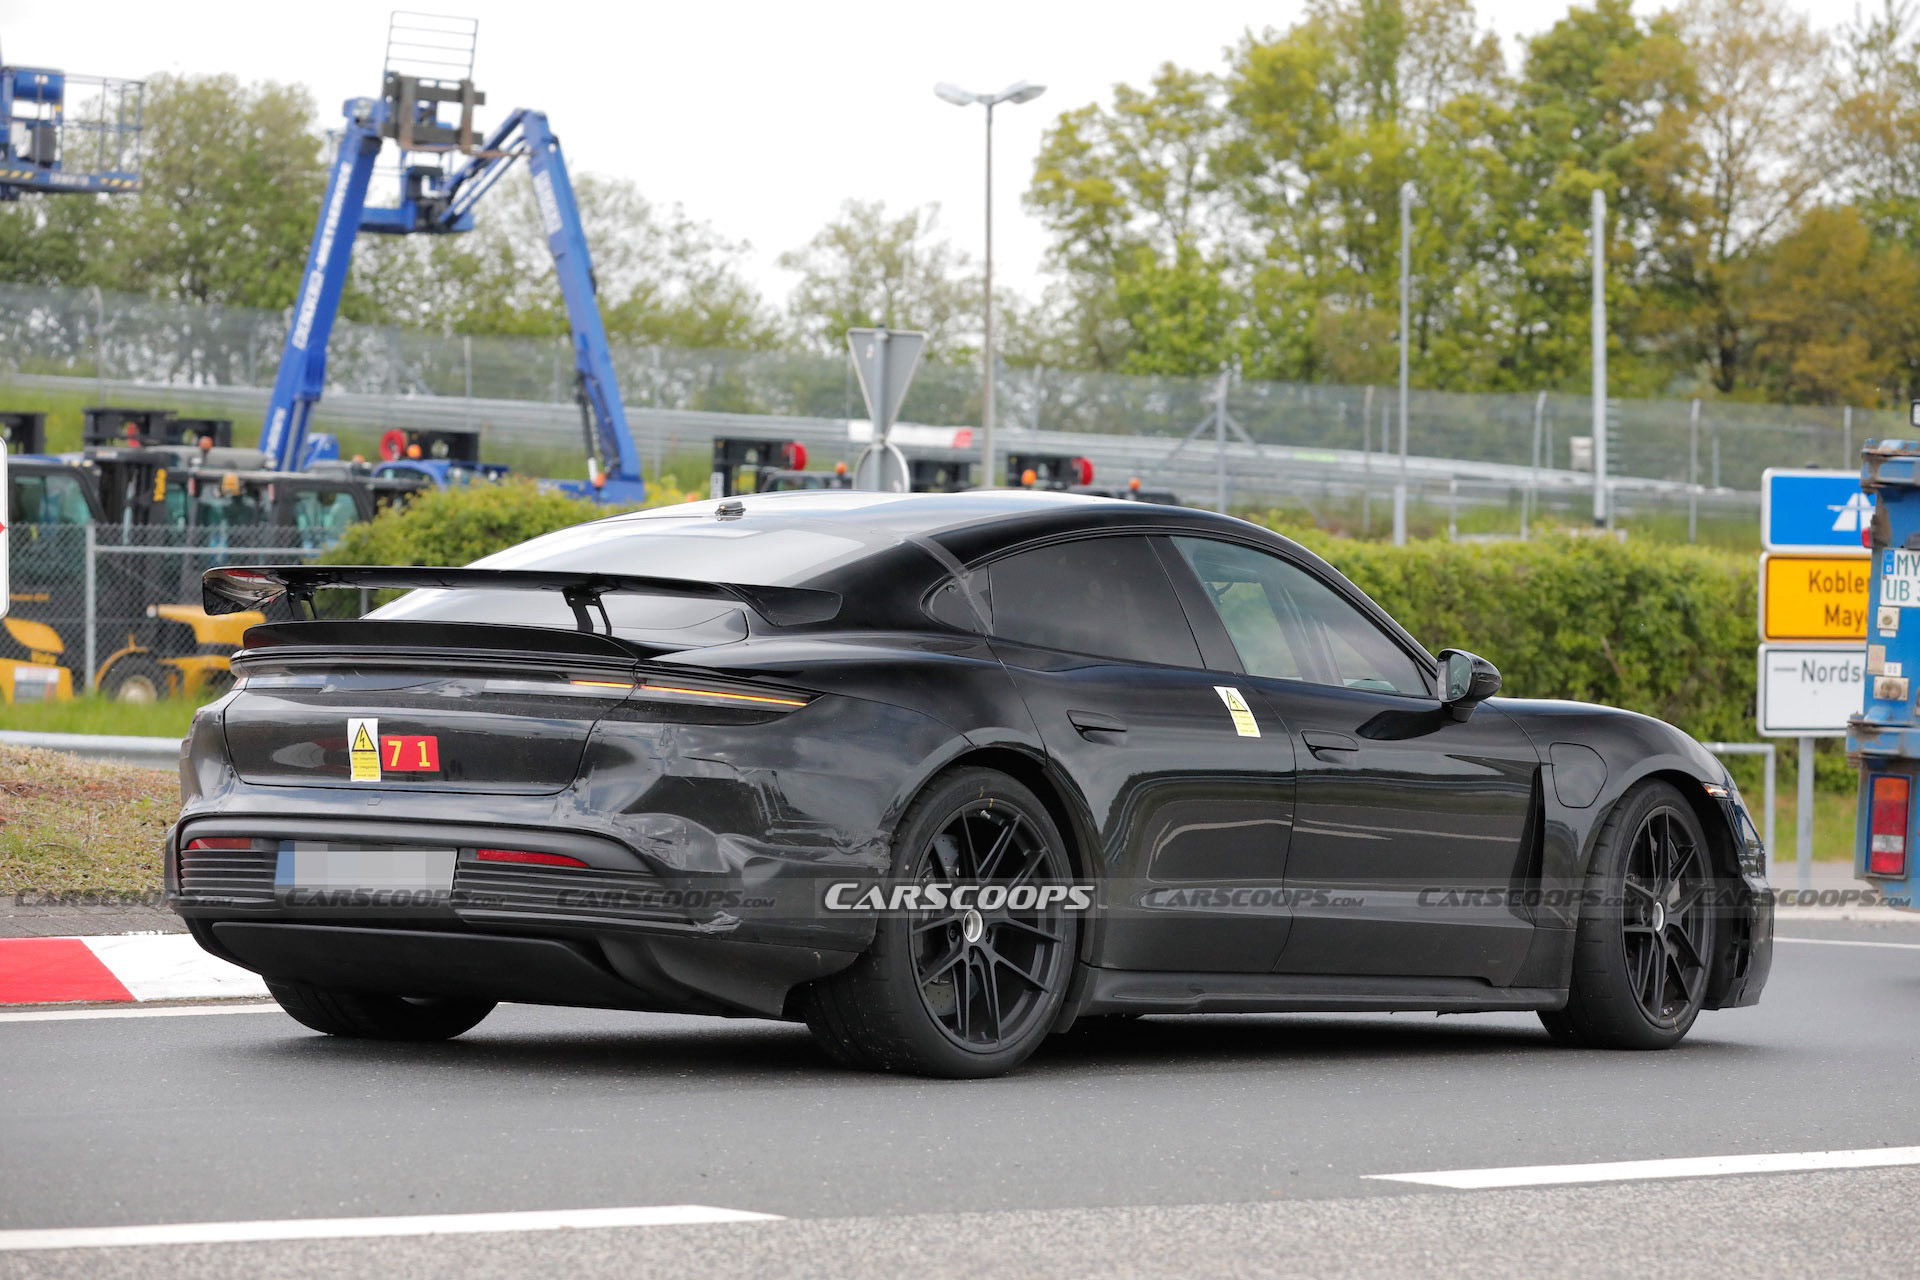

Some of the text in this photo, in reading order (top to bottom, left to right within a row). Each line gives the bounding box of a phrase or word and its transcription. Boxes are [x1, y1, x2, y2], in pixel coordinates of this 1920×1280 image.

[1808, 569, 1869, 594] Koble
[1886, 579, 1910, 601] UB
[1824, 603, 1868, 633] May
[1801, 659, 1865, 683] Nords
